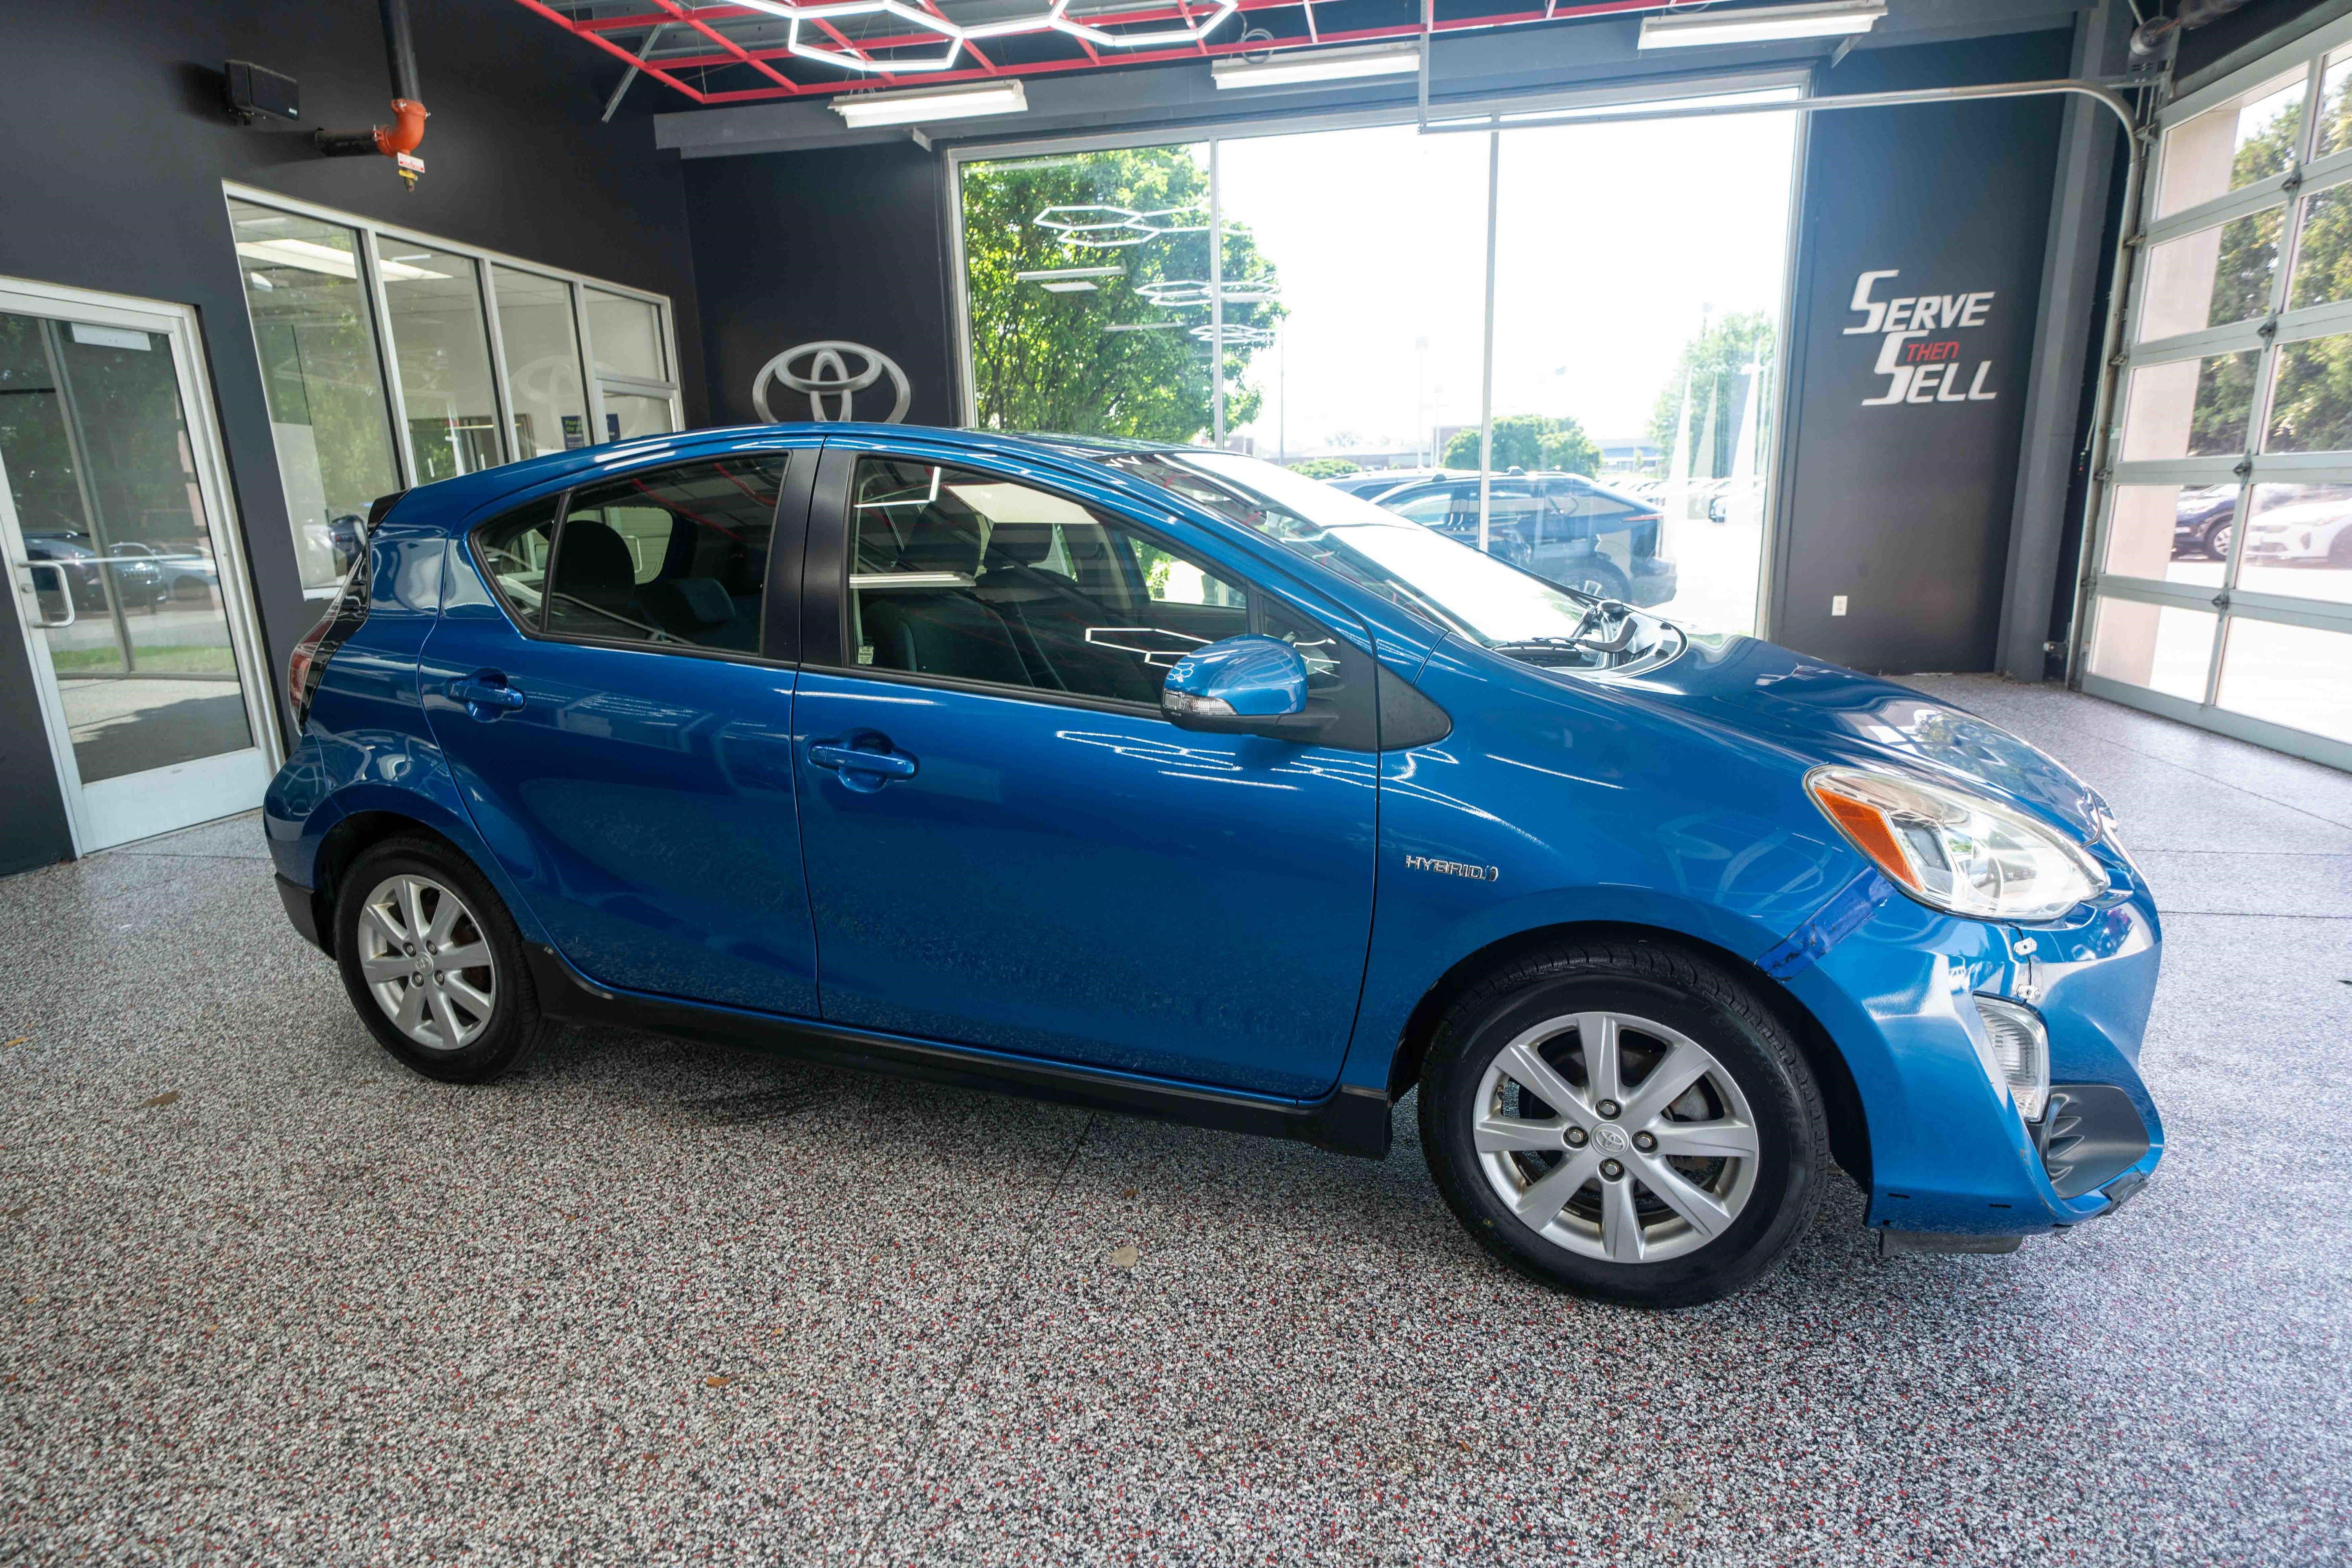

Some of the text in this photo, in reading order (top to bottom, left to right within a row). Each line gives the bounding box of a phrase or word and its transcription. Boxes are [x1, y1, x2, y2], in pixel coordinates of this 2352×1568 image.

[1842, 270, 1995, 335] SERVE
[1861, 329, 1997, 406] SELL
[1405, 855, 1485, 880] HYBRID
